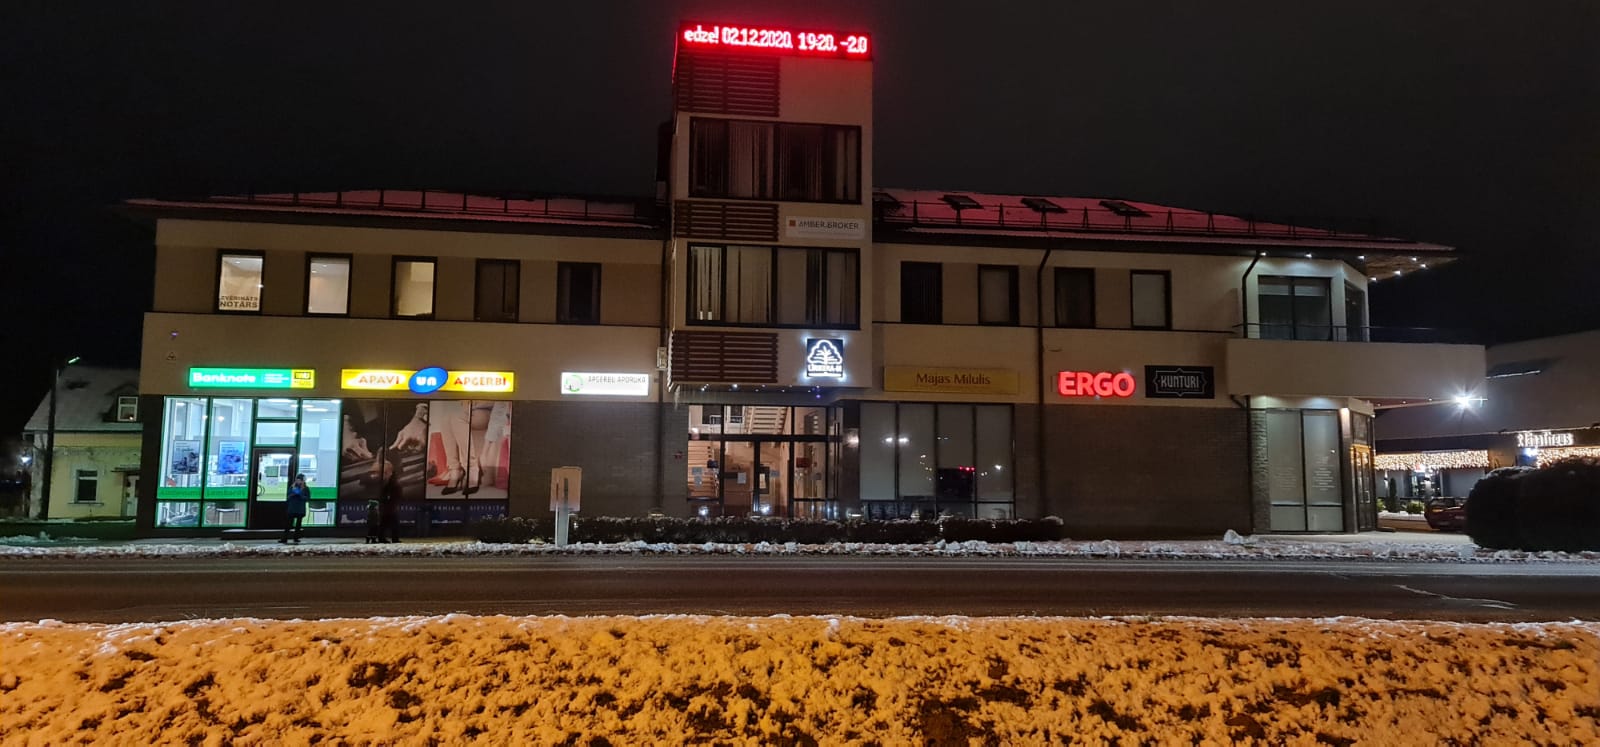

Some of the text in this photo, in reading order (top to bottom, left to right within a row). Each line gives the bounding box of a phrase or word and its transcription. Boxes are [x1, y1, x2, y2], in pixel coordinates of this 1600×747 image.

[683, 25, 719, 44] edze!
[722, 27, 793, 49] 02.12.2020.
[192, 371, 256, 383] Banknote
[358, 375, 400, 385] APAVI
[1058, 371, 1136, 397] ERGO
[1160, 375, 1200, 389] KUNTURI
